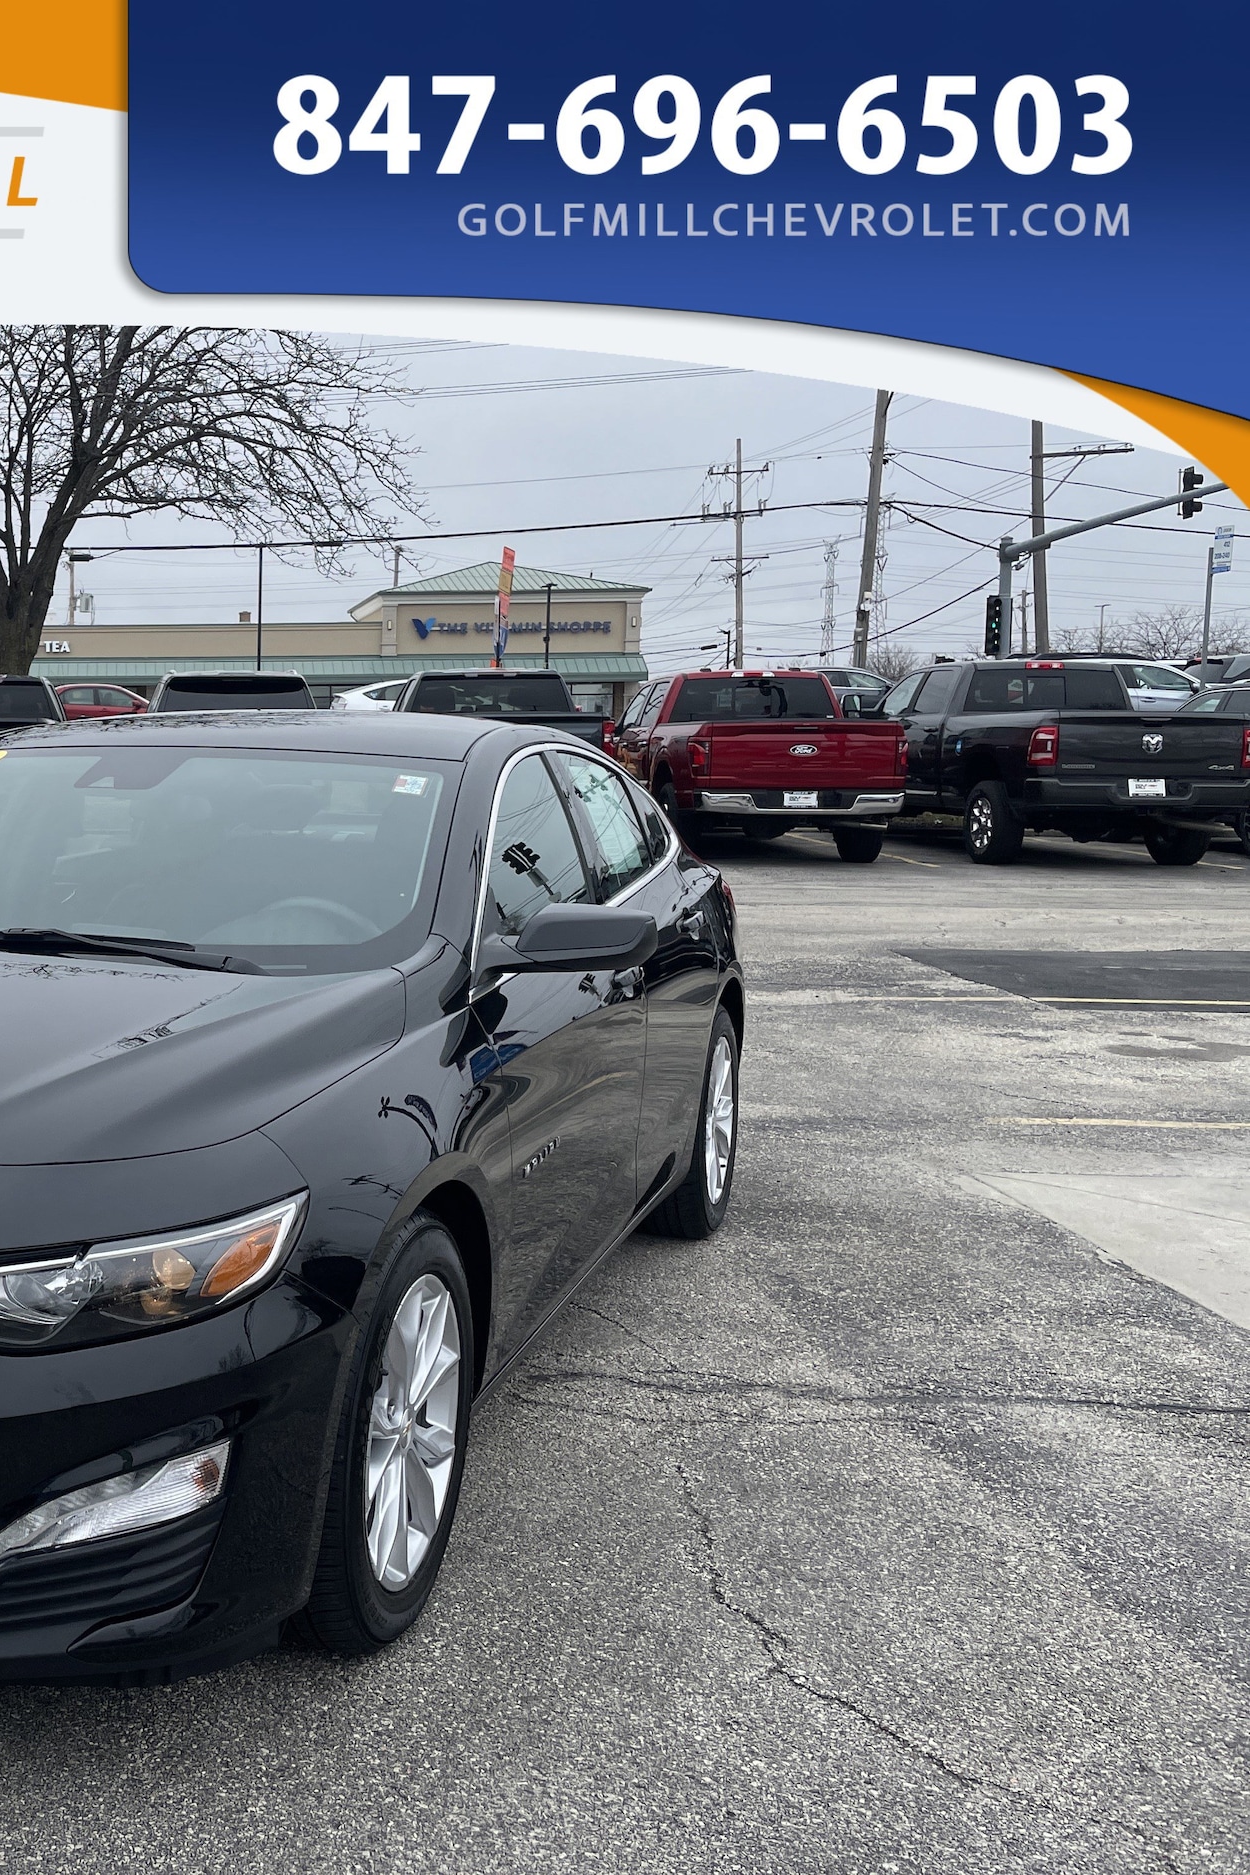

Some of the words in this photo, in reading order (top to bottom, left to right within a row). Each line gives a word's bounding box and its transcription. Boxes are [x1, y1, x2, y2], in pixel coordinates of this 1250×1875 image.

[438, 622, 468, 635] THE
[549, 620, 612, 634] SHOPPE
[44, 640, 71, 653] TEA
